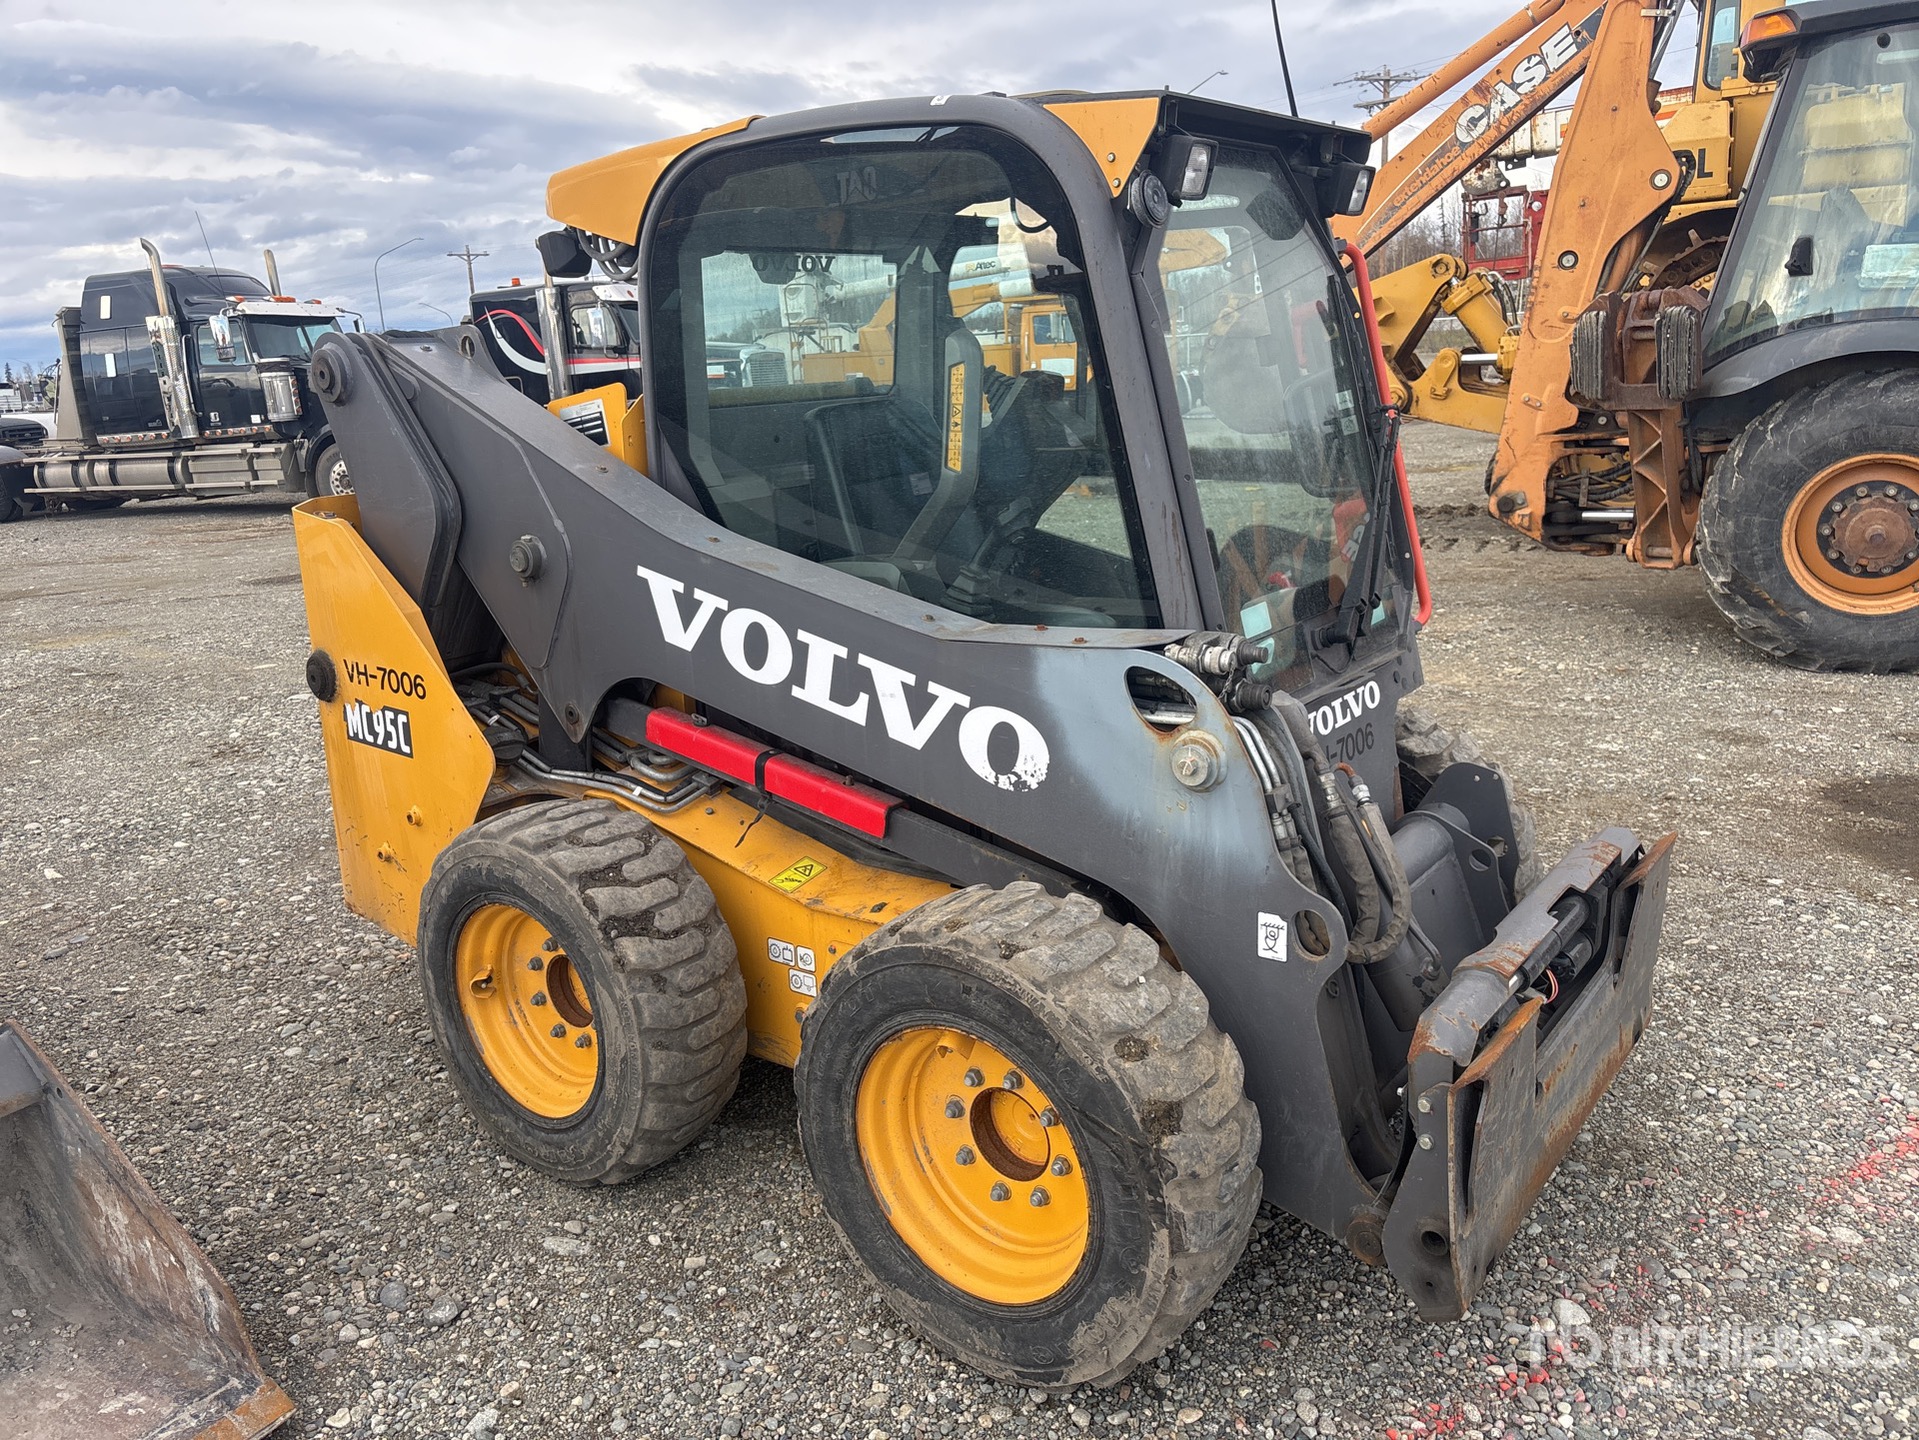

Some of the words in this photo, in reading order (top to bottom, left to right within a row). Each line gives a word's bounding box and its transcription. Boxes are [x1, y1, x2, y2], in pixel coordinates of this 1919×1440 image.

[1454, 21, 1578, 142] CASE
[343, 659, 426, 700] VH-7006
[637, 564, 1050, 792] VOLVO
[344, 702, 411, 754] MC95C
